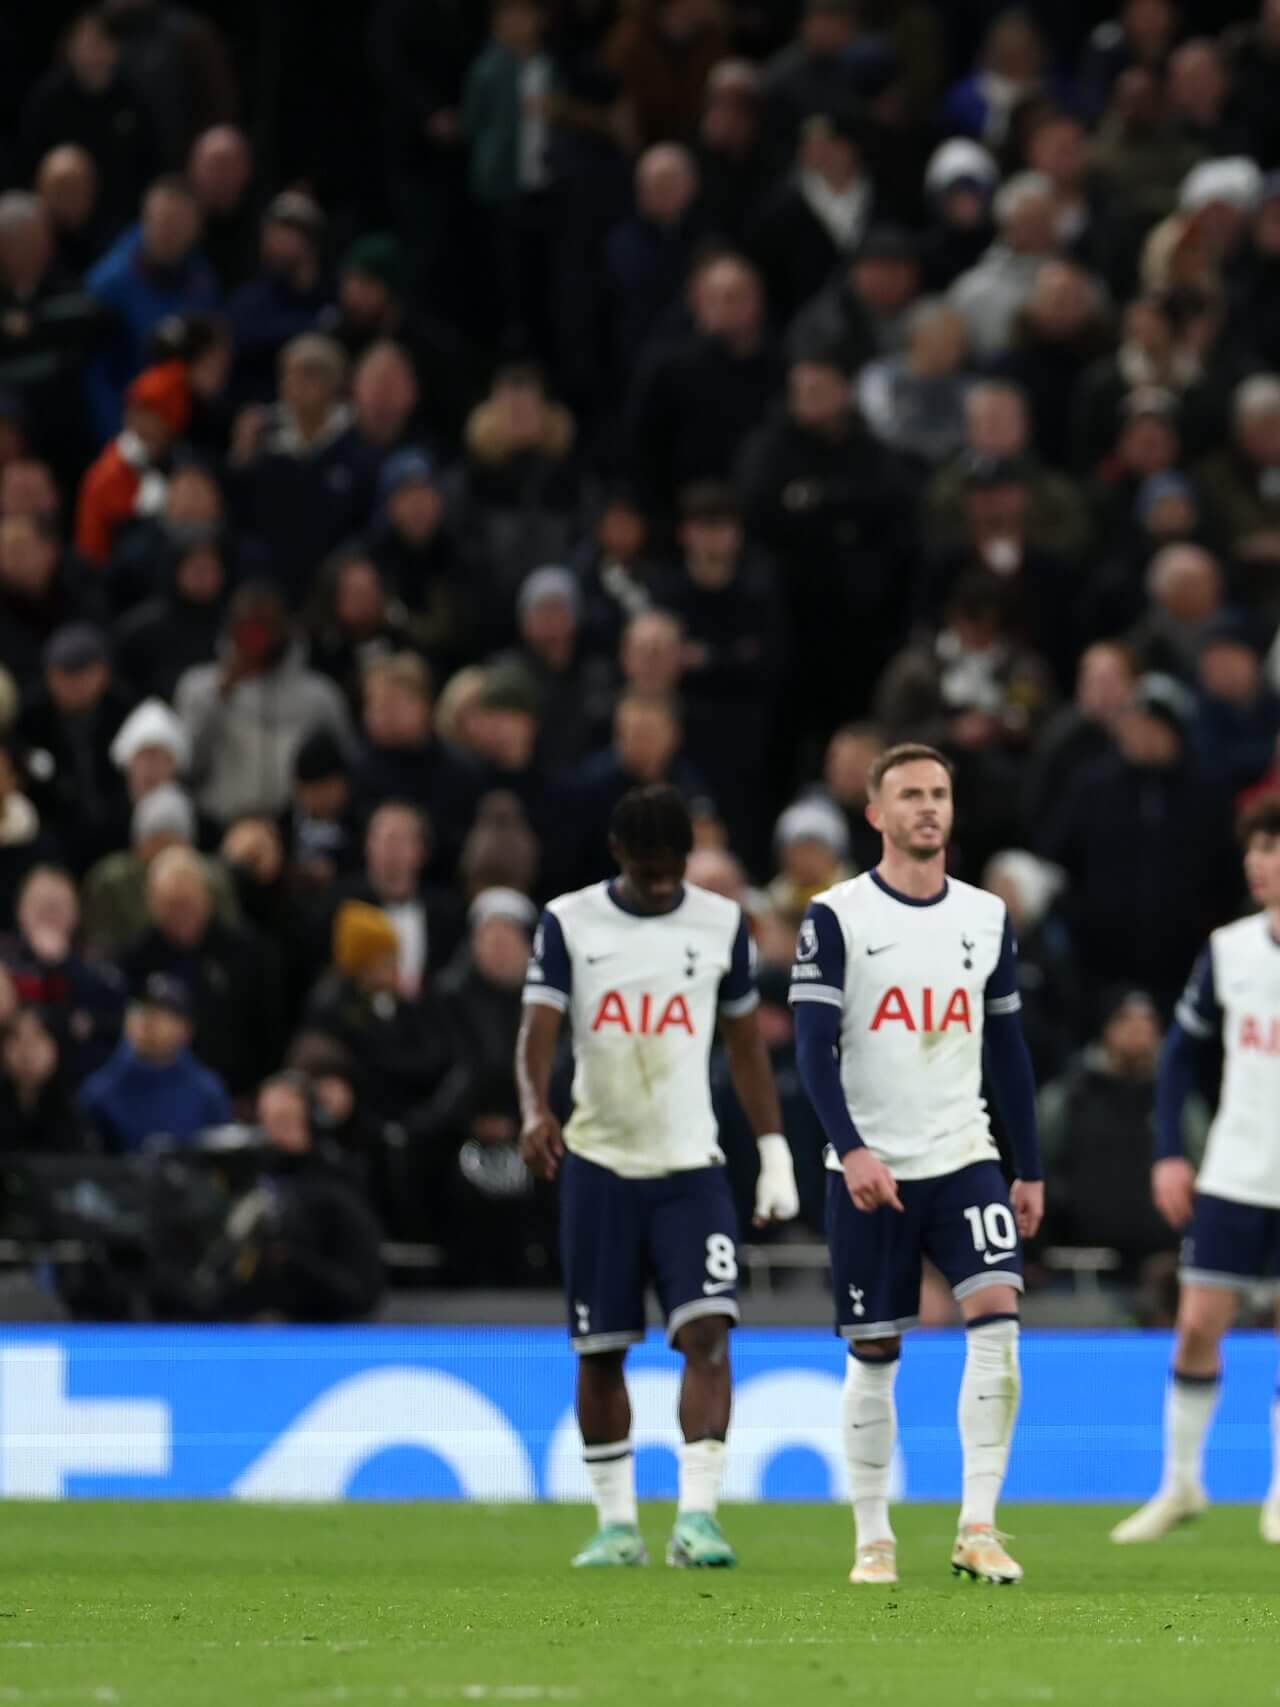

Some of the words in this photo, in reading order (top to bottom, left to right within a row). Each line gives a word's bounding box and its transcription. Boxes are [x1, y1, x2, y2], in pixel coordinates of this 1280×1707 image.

[593, 990, 694, 1035] AIA
[870, 986, 972, 1033] AIA
[964, 1203, 1018, 1252] 10
[706, 1233, 738, 1281] 8
